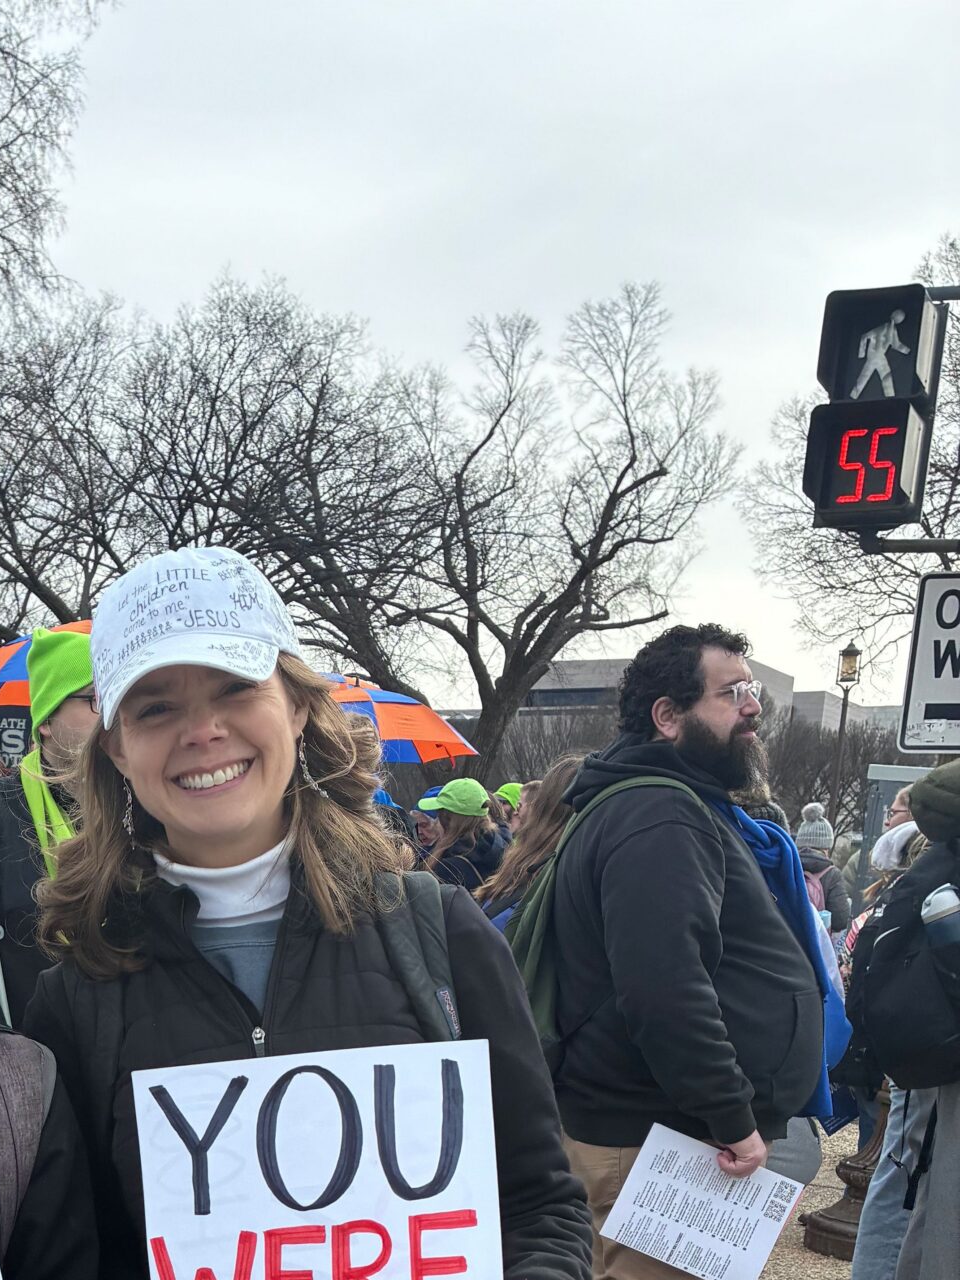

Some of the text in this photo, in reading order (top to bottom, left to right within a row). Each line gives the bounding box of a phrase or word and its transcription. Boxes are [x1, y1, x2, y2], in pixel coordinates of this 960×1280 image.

[836, 426, 900, 504] 55
[156, 567, 212, 586] LITTLE
[129, 580, 189, 622] children
[935, 588, 960, 630] O
[123, 617, 145, 638] come
[147, 608, 159, 619] to
[933, 639, 960, 679] W
[149, 1058, 465, 1215] YOU
